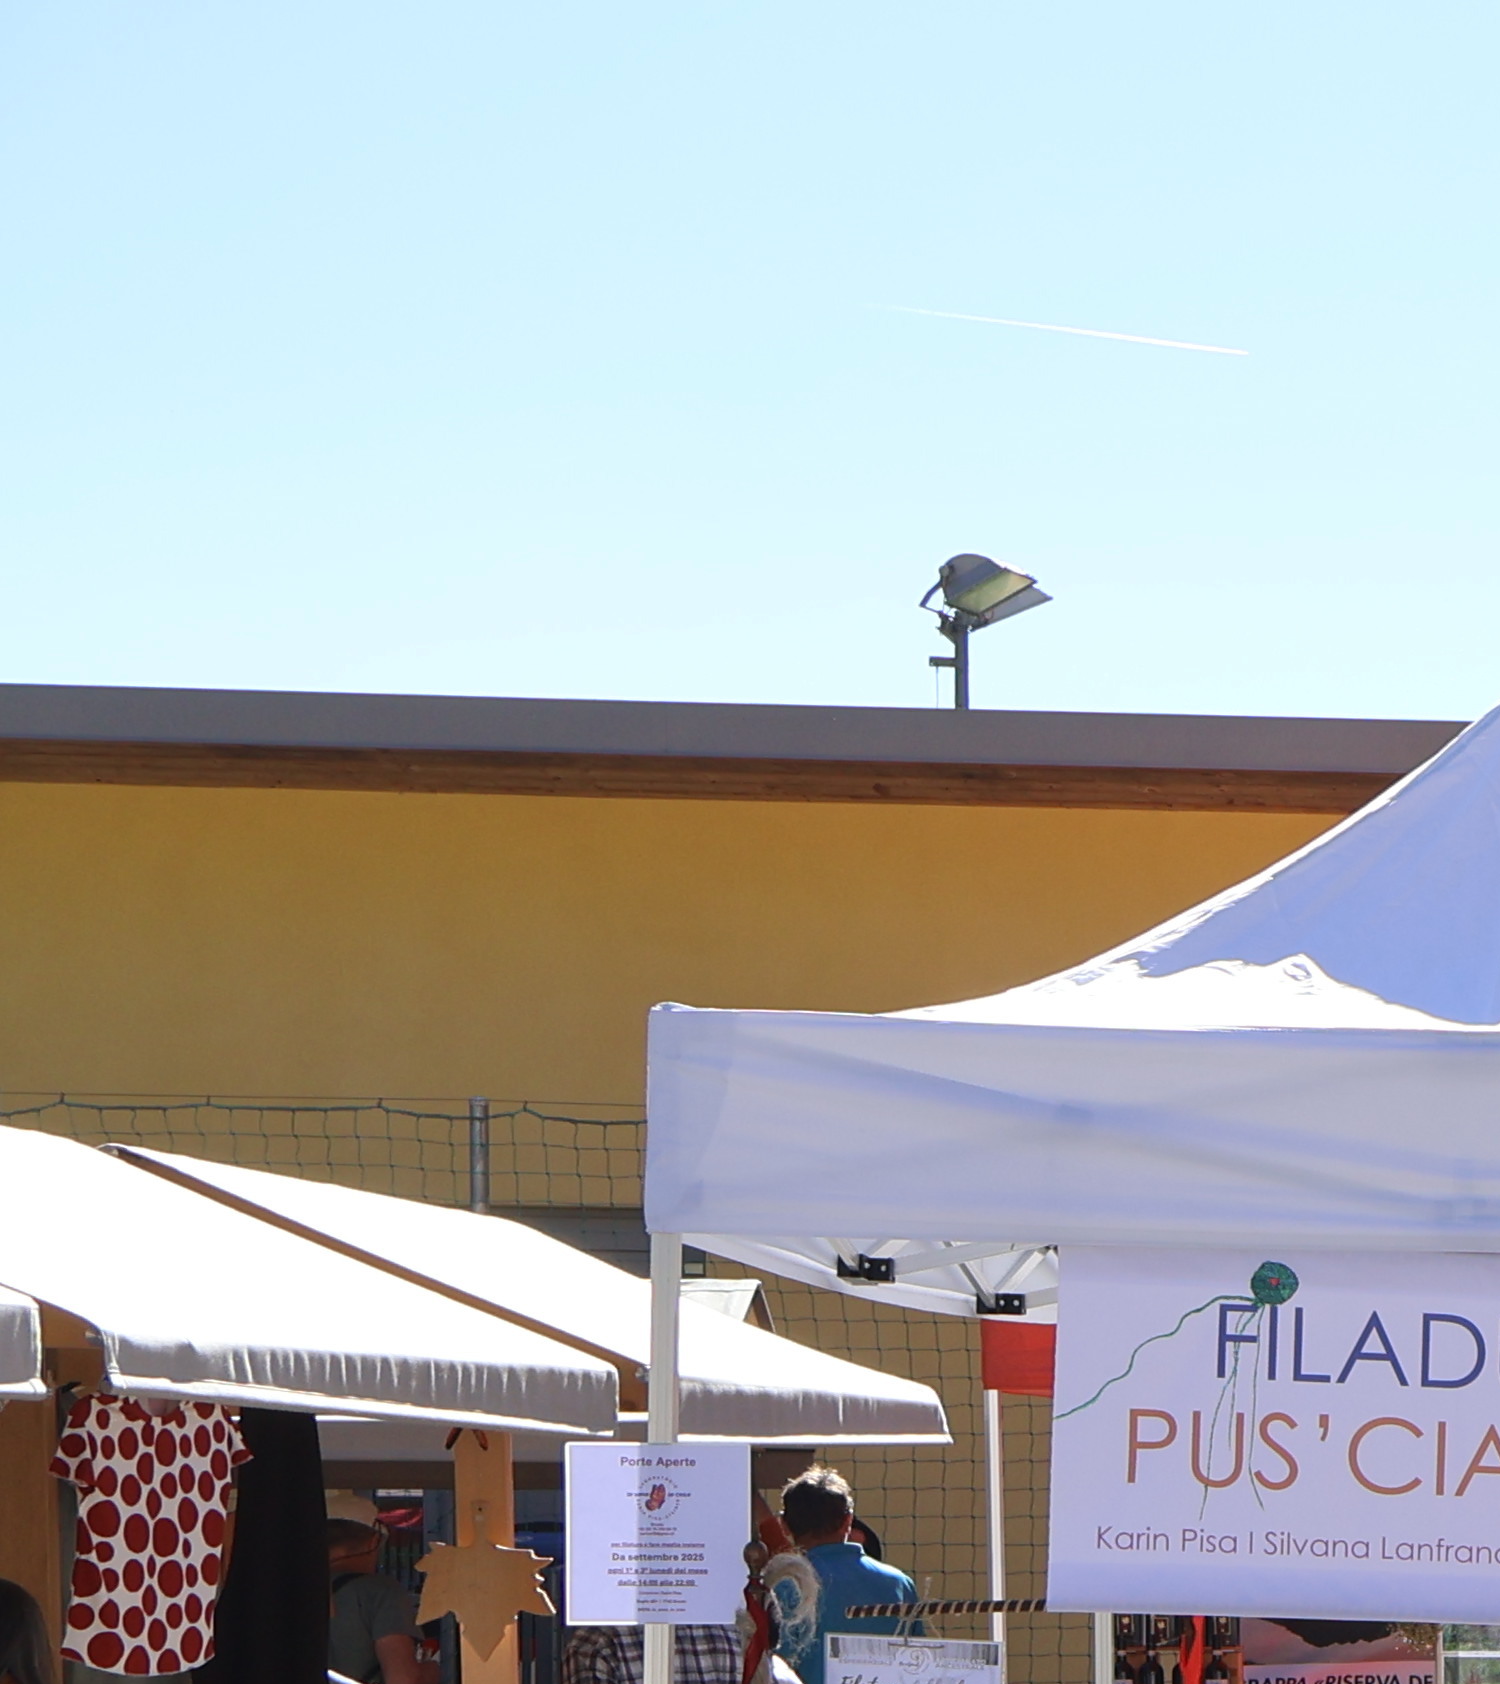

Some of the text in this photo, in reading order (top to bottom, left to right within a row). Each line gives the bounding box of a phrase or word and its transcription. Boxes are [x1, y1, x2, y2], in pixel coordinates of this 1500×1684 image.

[620, 1457, 696, 1468] Porte Aperte
[1096, 1526, 1170, 1552] Karin
[1181, 1528, 1238, 1555] Pisa
[1264, 1531, 1370, 1559] Silvana
[612, 1553, 704, 1561] Da settembre 2025
